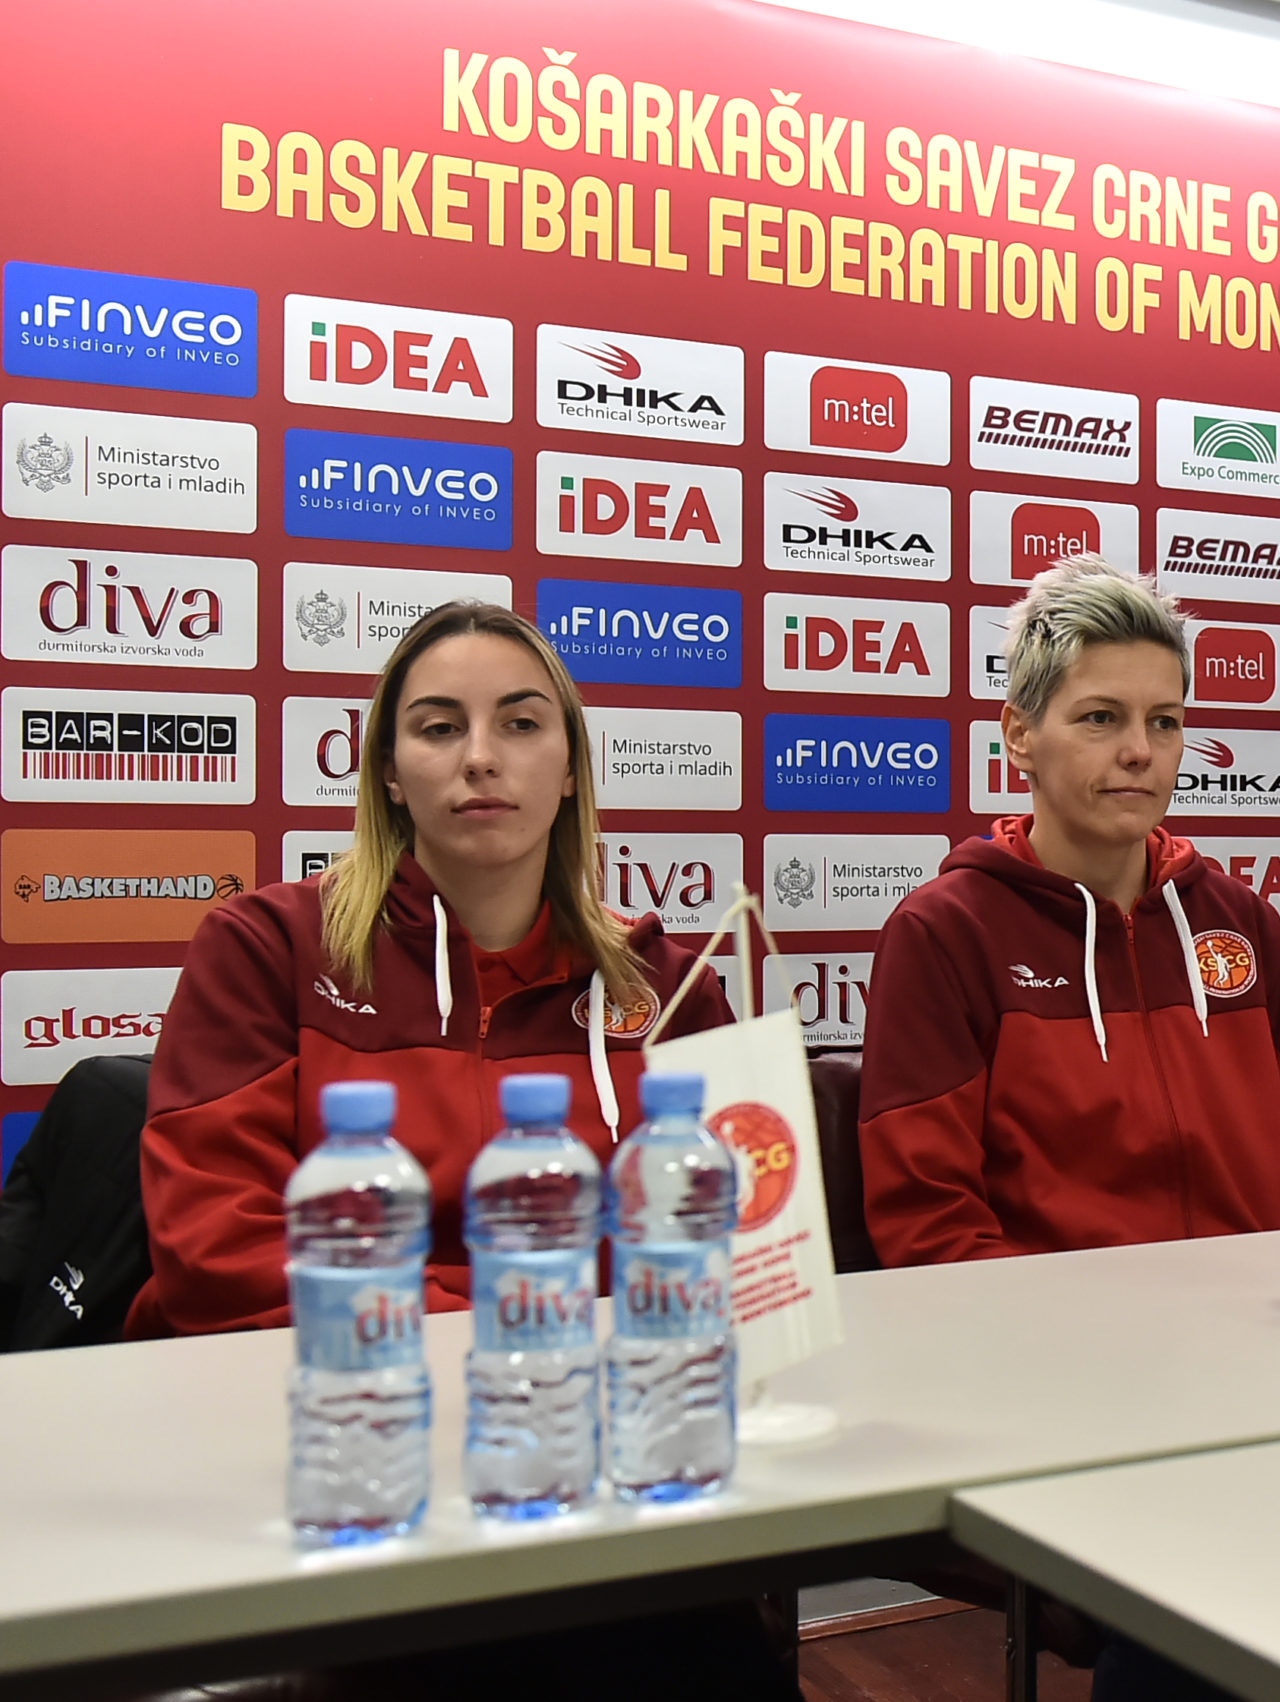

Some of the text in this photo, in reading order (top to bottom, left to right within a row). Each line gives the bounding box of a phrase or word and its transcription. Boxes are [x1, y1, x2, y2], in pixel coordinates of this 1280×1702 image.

[442, 46, 865, 197] KOŠARKAŠKI
[885, 126, 1076, 231] SAVEZ
[1091, 163, 1231, 256] CRNE
[220, 122, 689, 272] BASKETBALL
[708, 197, 1076, 324] FEDERATION
[1095, 256, 1163, 334] OF
[48, 295, 243, 347] FINVEO
[21, 332, 239, 365] Subsidiary of INVEO
[558, 380, 725, 420] DHIKA
[825, 397, 895, 427] m:tel
[558, 403, 725, 430] Technical Sportswear
[982, 405, 1132, 443] BEMAX
[99, 446, 219, 470] Ministarstvo
[1182, 462, 1214, 480] Expo
[97, 471, 244, 494] sporta i mladih
[324, 460, 498, 501] FINVEO
[300, 495, 496, 520] Subsidiary of INVEO
[783, 524, 934, 556] DHIKA
[1023, 529, 1089, 558] m:tel
[783, 546, 935, 567] Technical Sportswear
[40, 559, 222, 641] diva
[369, 600, 434, 618] Minista
[368, 624, 411, 642] spor
[572, 607, 729, 642] FINVEO
[39, 640, 203, 657] durmitorska izvorska voda
[551, 640, 727, 660] Subsidiary of INVEO
[1206, 653, 1264, 680] m:tel
[26, 716, 233, 749] BAR-KOD
[613, 739, 711, 755] Ministarstvo
[797, 740, 938, 769] FINVEO
[613, 761, 732, 778] sporta i mladih
[777, 773, 936, 787] Subsidiary of INVEO
[1172, 793, 1227, 805] Technical
[602, 842, 717, 911] iva
[833, 864, 922, 877] Ministarstvo
[43, 873, 215, 901] BASKETHAND
[833, 885, 879, 901] sporta
[884, 883, 889, 896] i
[675, 913, 700, 924] voda
